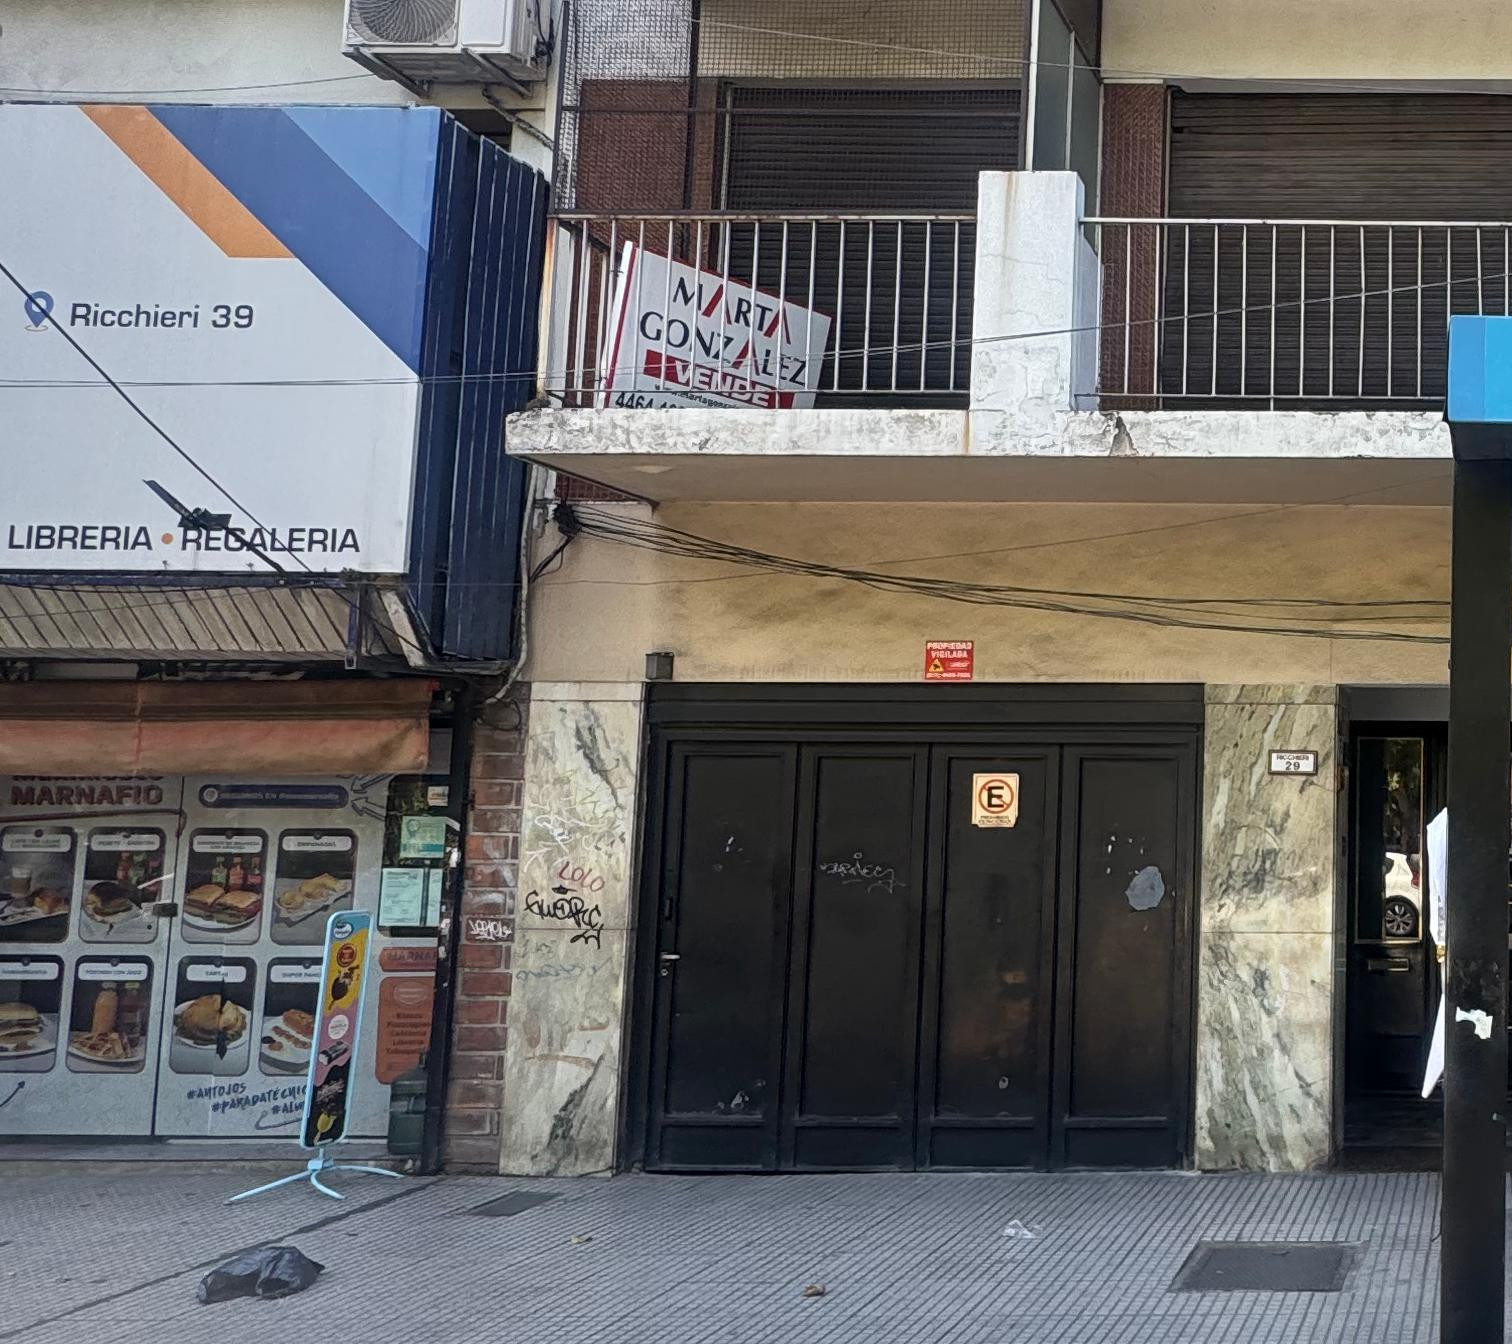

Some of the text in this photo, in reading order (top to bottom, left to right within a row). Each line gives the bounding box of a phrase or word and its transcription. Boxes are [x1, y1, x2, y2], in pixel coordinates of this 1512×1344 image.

[70, 302, 254, 329] Ricchieri 39
[673, 277, 791, 345] MARTA
[640, 311, 808, 387] GONZALEZ
[674, 360, 770, 407] VENDE
[9, 525, 360, 553] LIBRERIA REGALERIA
[1285, 761, 1300, 771] 29
[987, 786, 1005, 808] E
